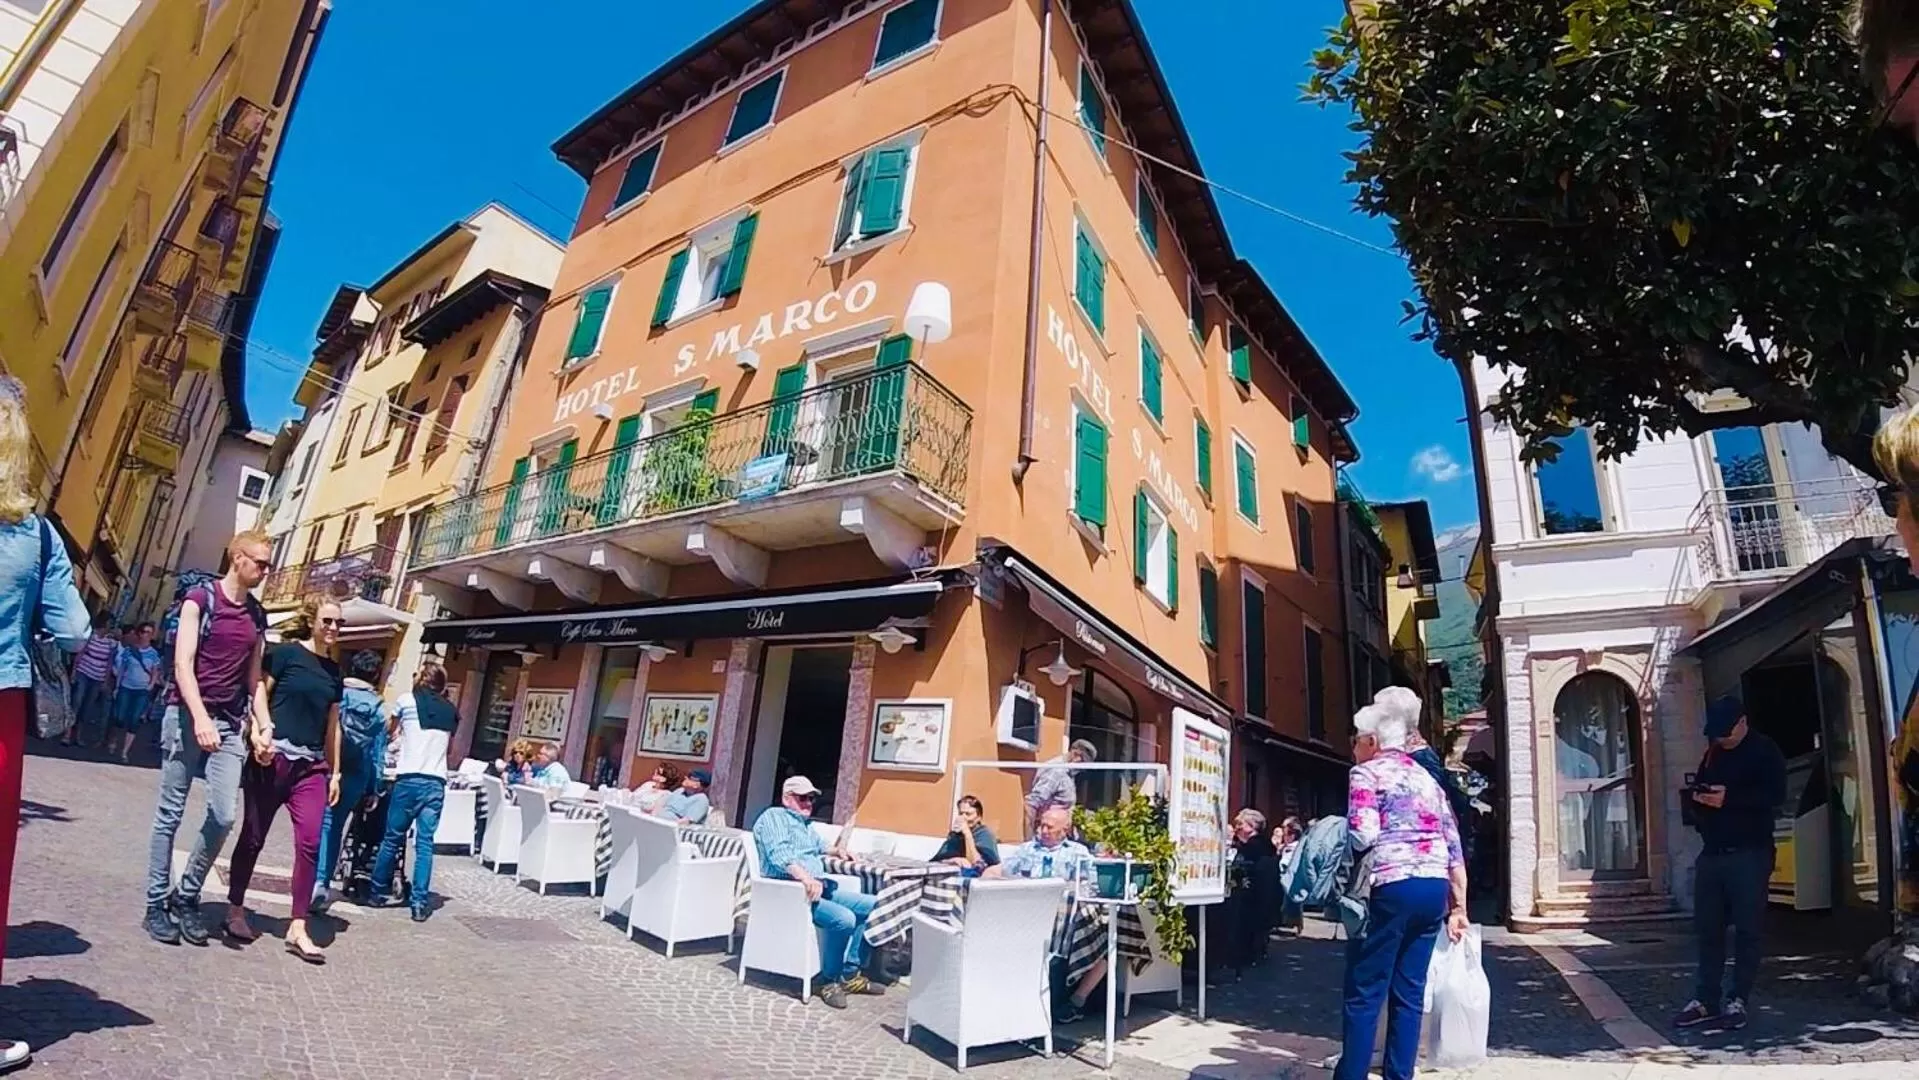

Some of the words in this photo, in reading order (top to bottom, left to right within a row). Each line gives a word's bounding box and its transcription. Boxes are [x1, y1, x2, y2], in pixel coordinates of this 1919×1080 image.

[553, 366, 641, 423] HOTEL
[705, 280, 877, 361] MARCO
[1047, 303, 1114, 424] HOTEL
[1149, 451, 1199, 533] MARCO
[747, 608, 785, 630] Hotel
